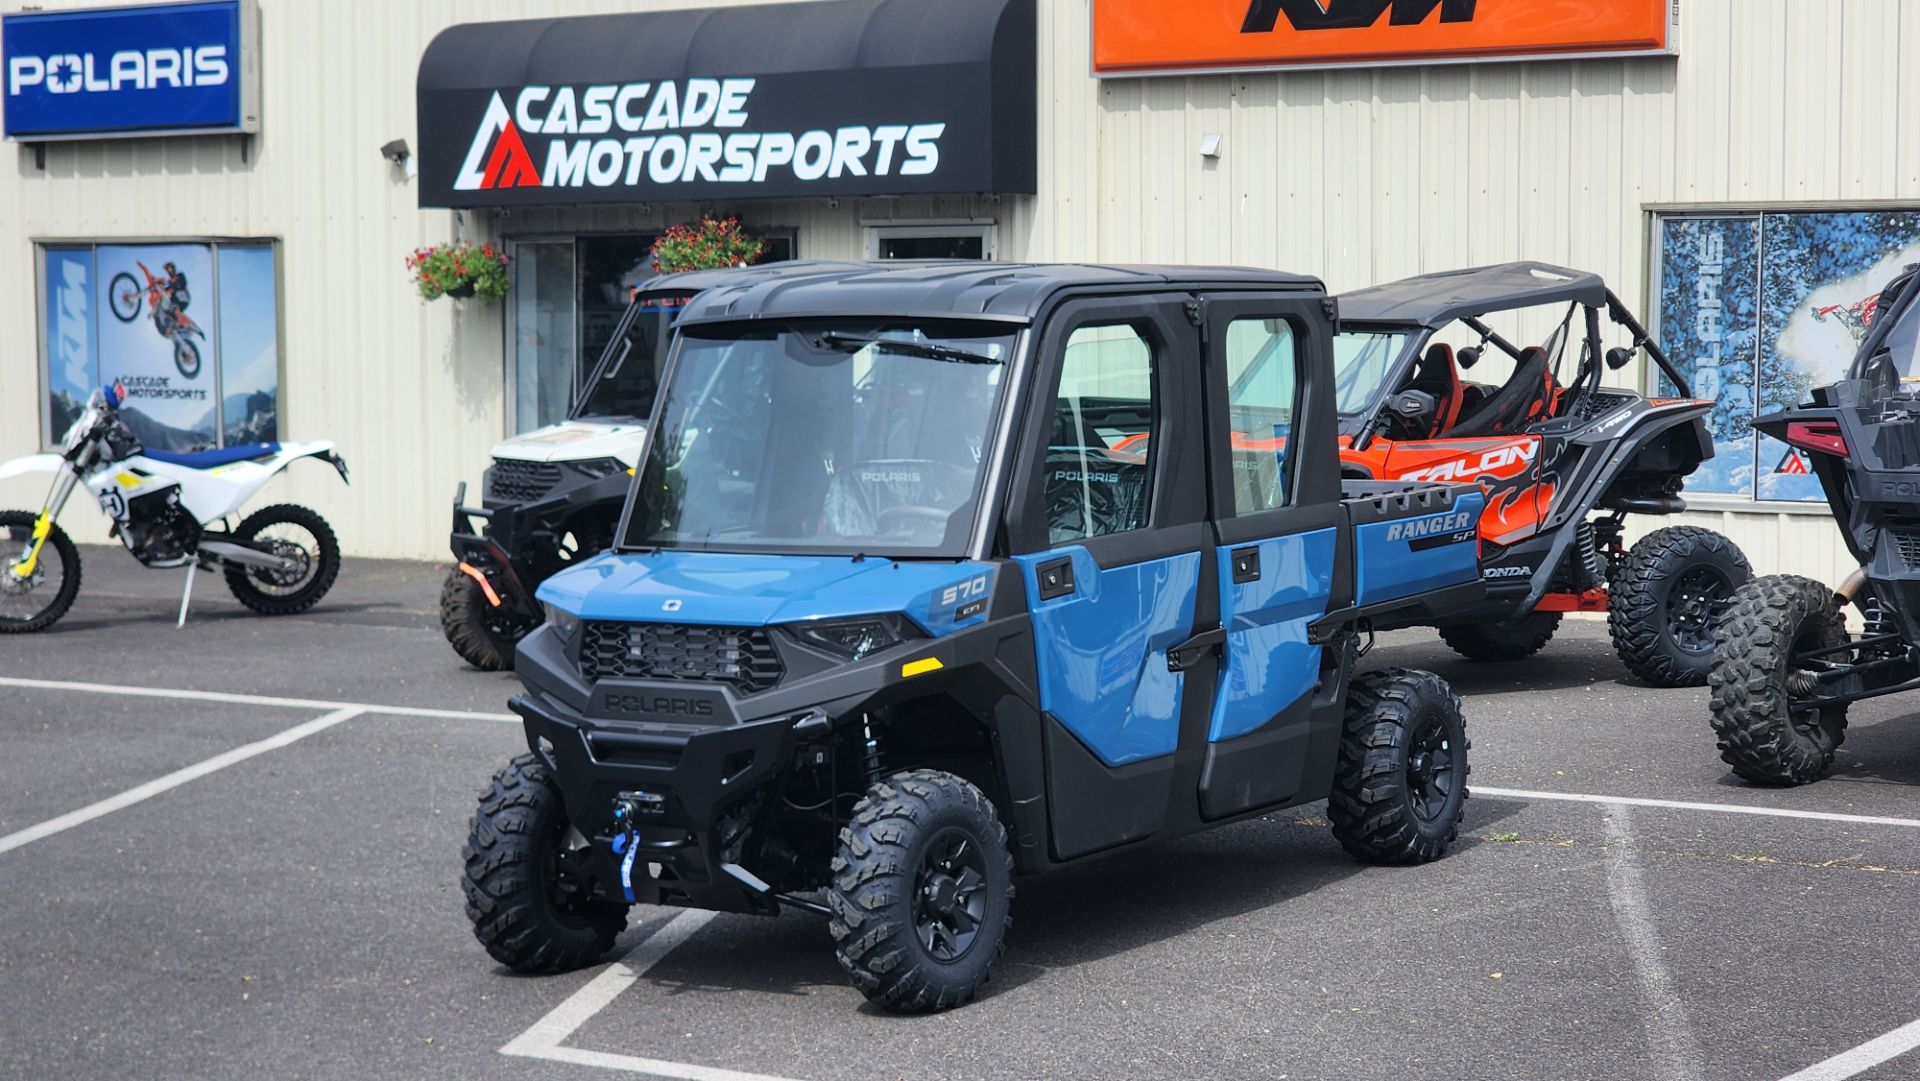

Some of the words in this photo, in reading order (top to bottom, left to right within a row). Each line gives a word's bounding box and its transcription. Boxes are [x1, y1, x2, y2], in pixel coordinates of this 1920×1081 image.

[9, 44, 229, 96] POLARIS
[515, 77, 756, 134] CASCADE
[541, 123, 946, 187] MOTORSPORTS
[57, 259, 89, 393] KTM
[121, 375, 171, 387] CASCADE
[127, 387, 207, 400] MOTORSPORTS
[861, 471, 921, 483] POLARIS
[1054, 470, 1120, 484] POLARIS
[1386, 511, 1470, 541] RANGER
[1452, 530, 1477, 543] SP
[604, 694, 713, 716] POLARIS
